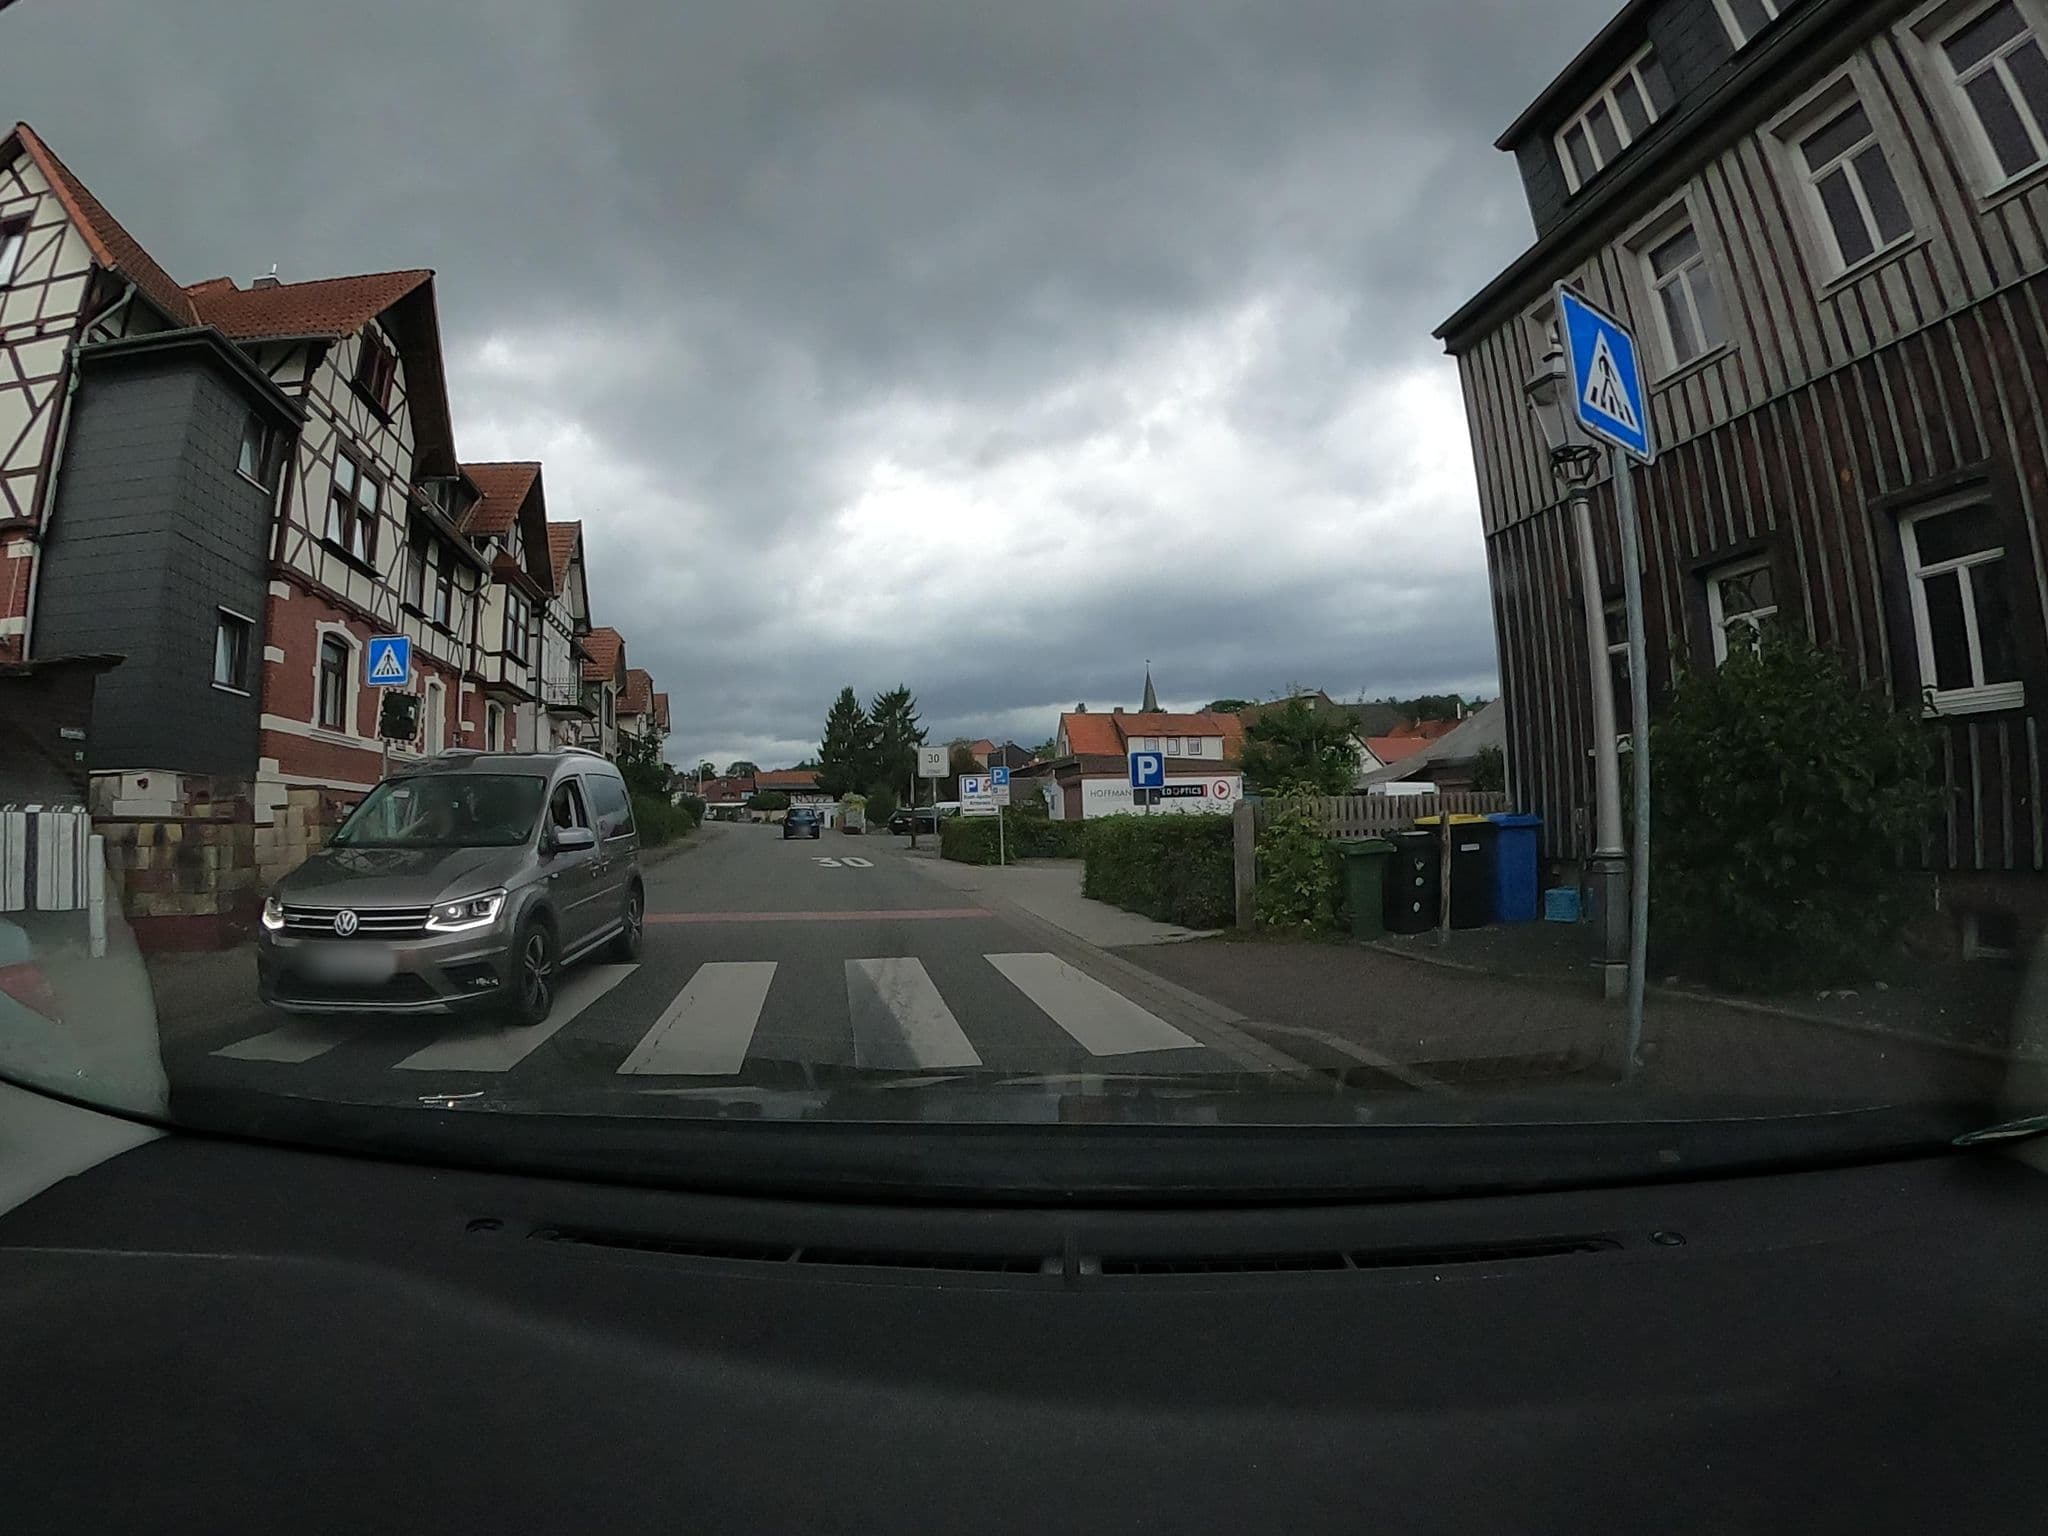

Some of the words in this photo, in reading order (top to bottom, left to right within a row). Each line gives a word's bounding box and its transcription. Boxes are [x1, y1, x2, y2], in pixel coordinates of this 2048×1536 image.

[927, 753, 940, 764] 30
[993, 769, 1003, 784] P
[1137, 755, 1158, 785] P
[966, 779, 977, 793] P
[811, 857, 874, 868] 30
